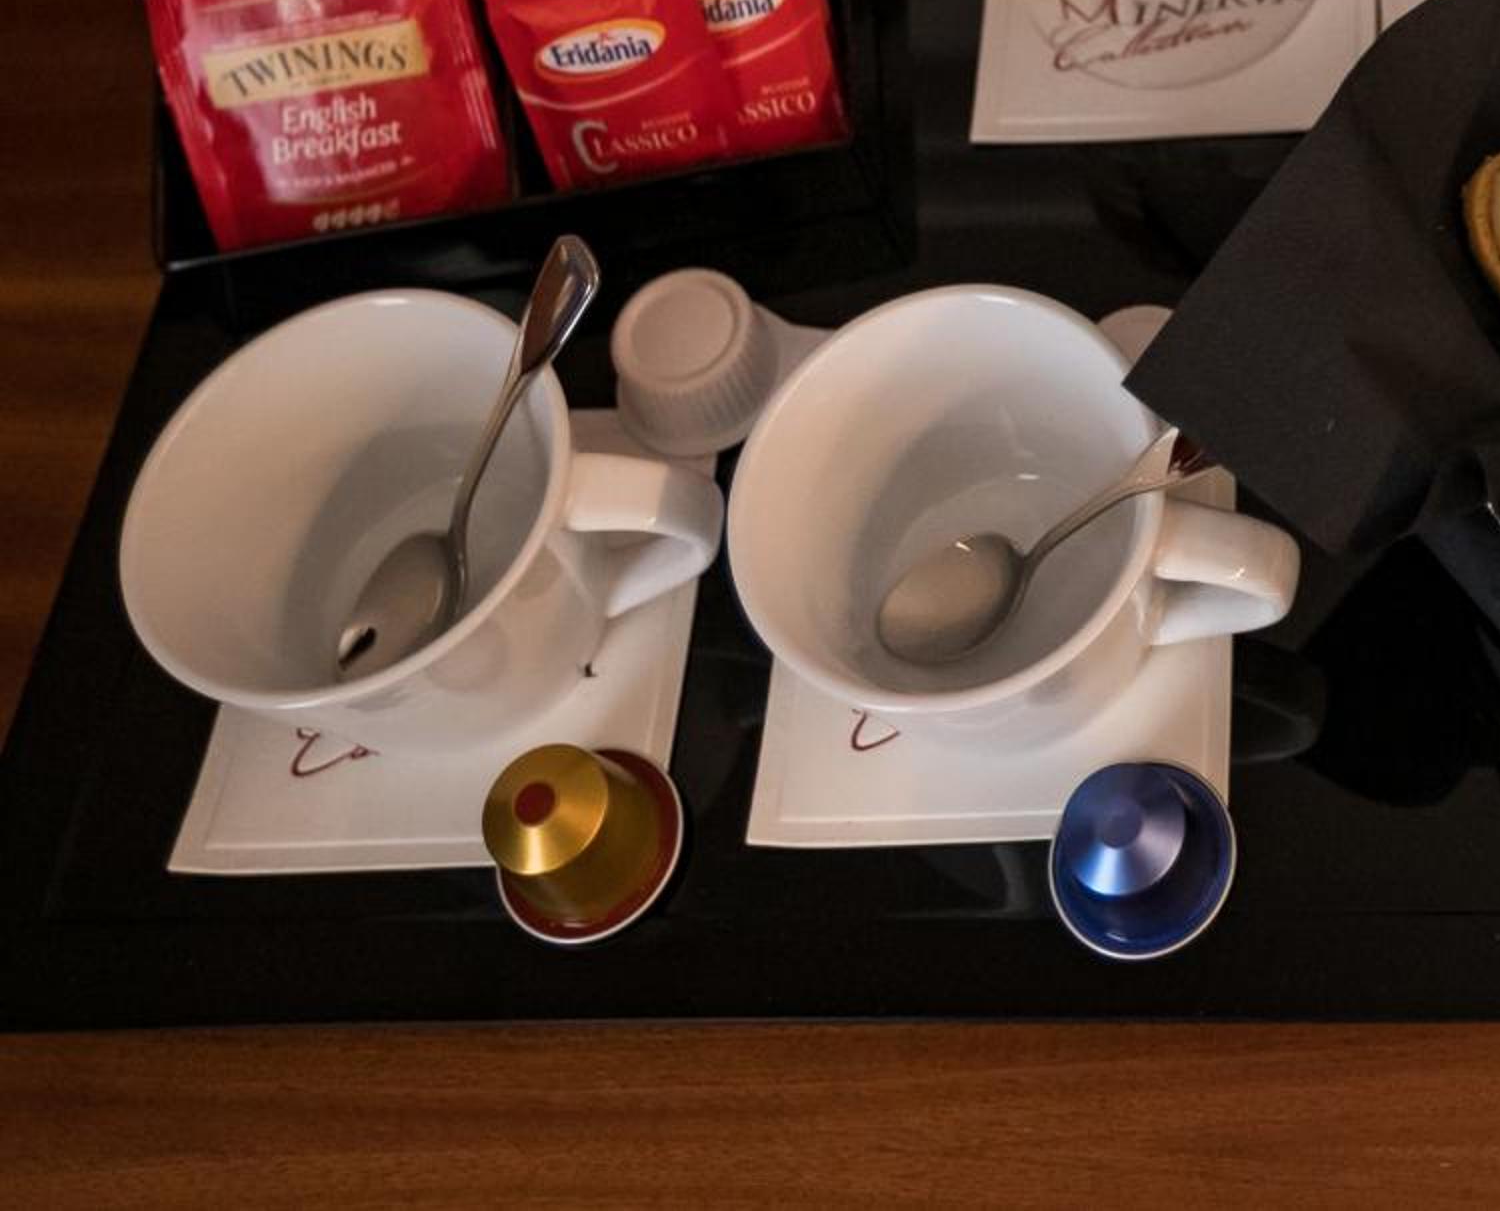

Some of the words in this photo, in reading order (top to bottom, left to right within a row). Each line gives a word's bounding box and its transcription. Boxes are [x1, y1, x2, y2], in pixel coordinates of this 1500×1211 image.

[220, 37, 409, 98] TWININGS
[549, 33, 653, 70] Eridania
[282, 93, 377, 135] English
[271, 120, 401, 166] Breakfast
[572, 118, 699, 174] CLASSICO
